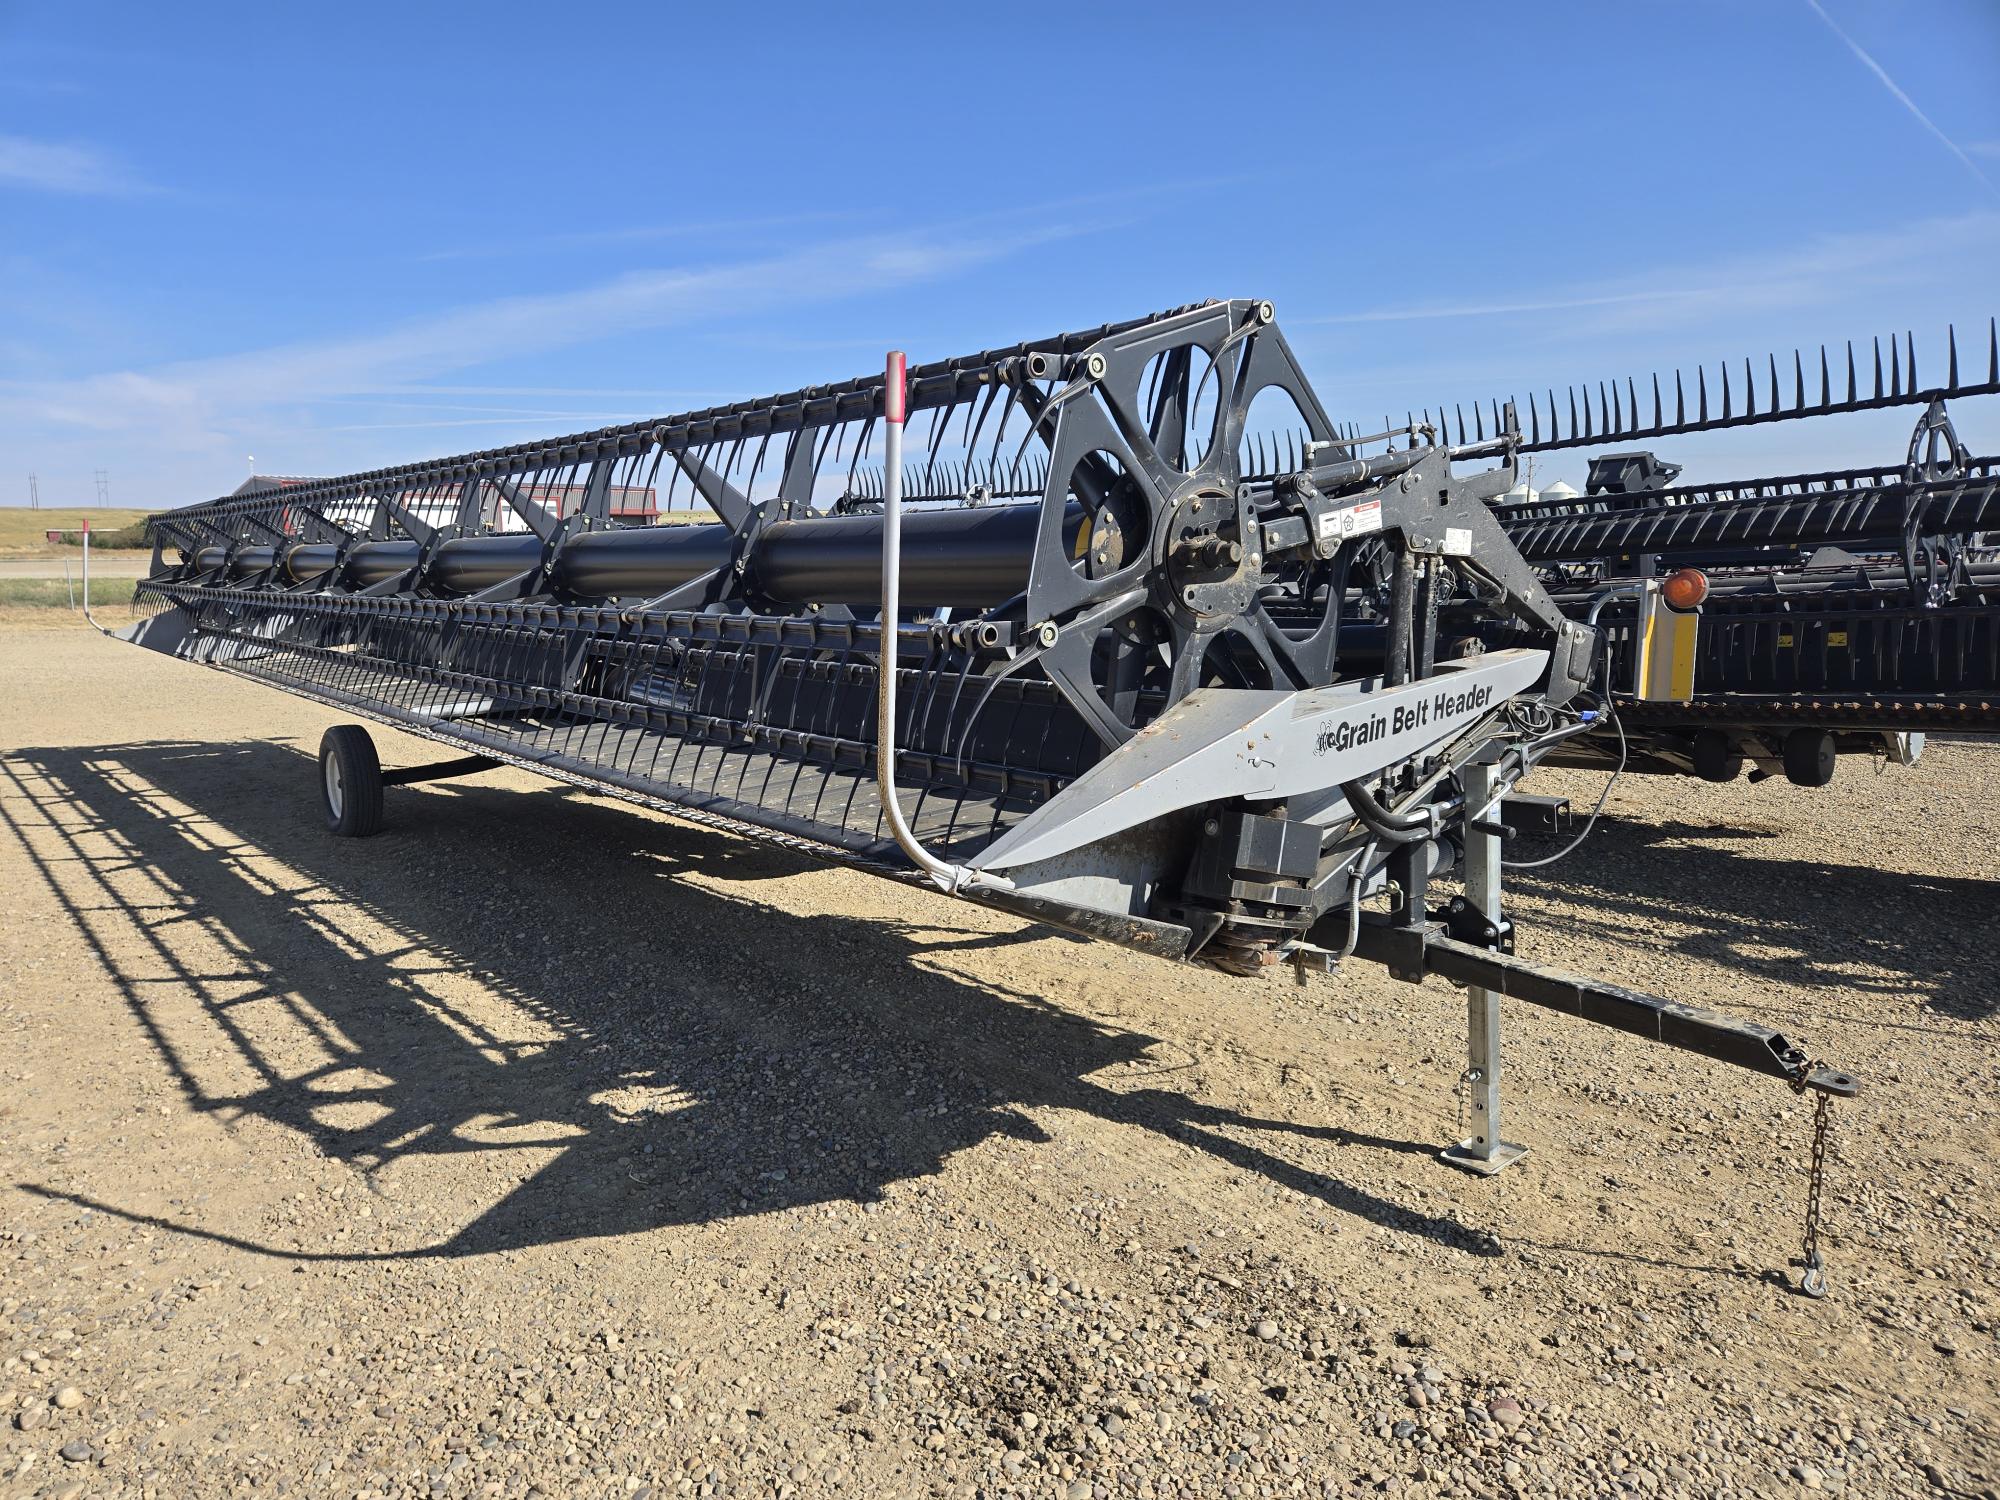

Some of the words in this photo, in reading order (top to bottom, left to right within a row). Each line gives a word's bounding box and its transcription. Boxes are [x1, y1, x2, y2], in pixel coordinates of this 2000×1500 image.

[1335, 714, 1387, 752] Grain
[1392, 698, 1429, 736] Belt
[1433, 684, 1493, 722] Header
